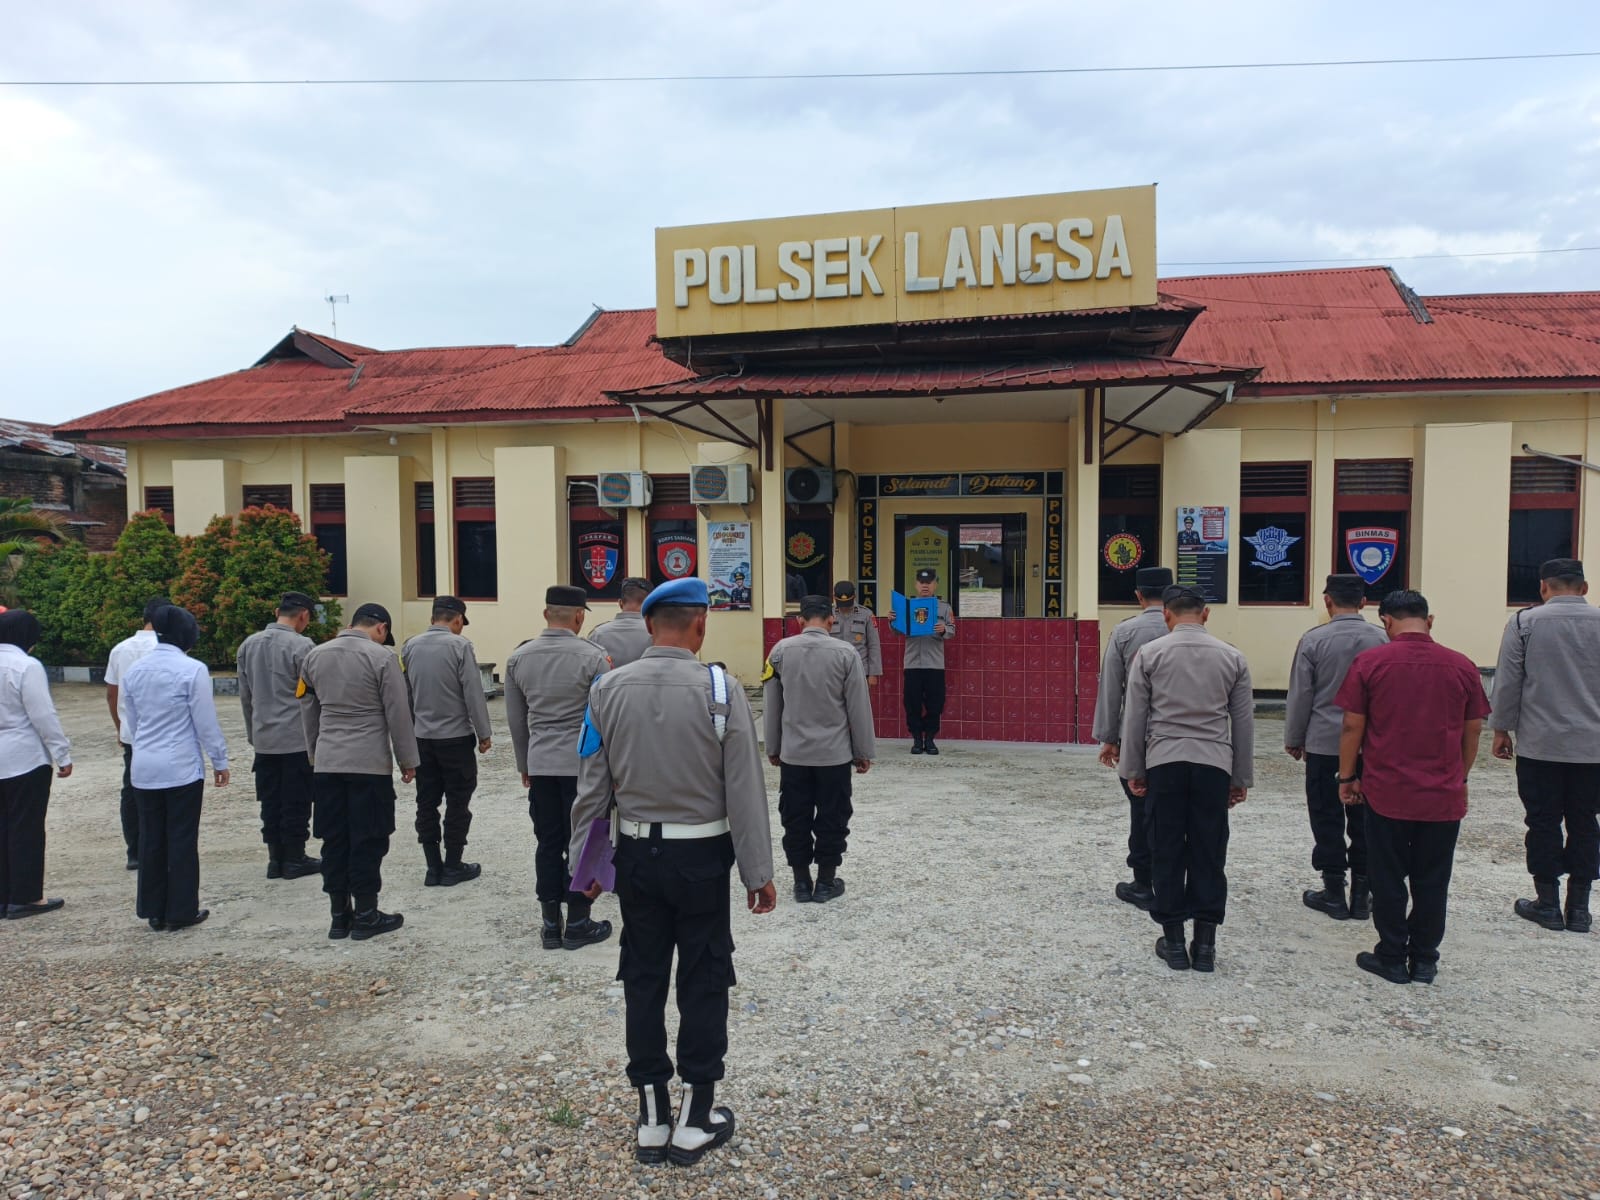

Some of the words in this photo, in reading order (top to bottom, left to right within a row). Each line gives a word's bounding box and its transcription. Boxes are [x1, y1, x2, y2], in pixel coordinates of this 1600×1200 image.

[673, 234, 885, 308] POLSEK
[904, 214, 1133, 293] LANGSA
[884, 475, 956, 493] Selamat
[969, 474, 1038, 494] Datang
[861, 502, 874, 577] POLSEK
[1047, 500, 1060, 577] POLSEK
[1355, 530, 1390, 538] BINMAS
